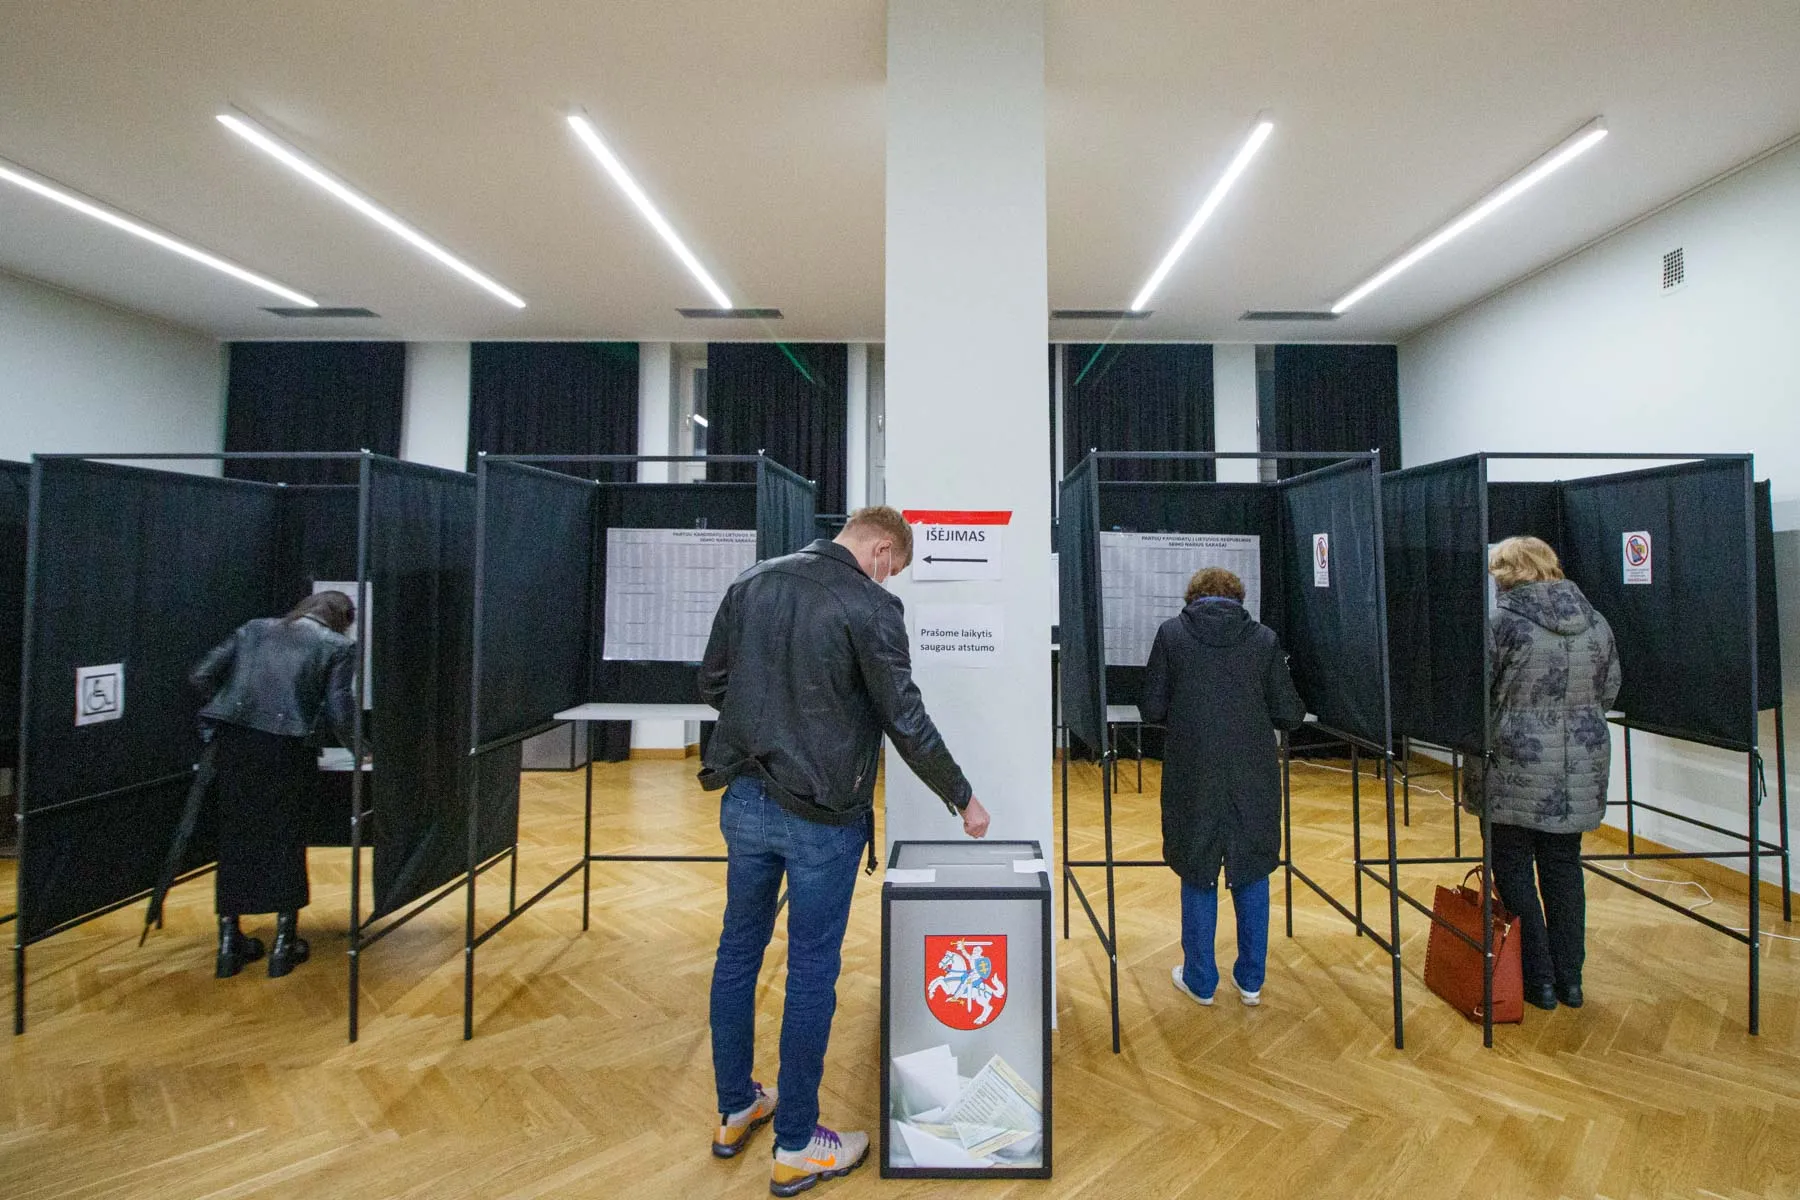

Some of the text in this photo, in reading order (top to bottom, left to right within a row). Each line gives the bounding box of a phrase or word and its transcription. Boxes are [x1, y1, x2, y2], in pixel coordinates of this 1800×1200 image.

[926, 527, 985, 542] IŠĖJIMAS
[921, 628, 992, 639] Prašome laikytis
[920, 643, 995, 653] saugaus atstumo
